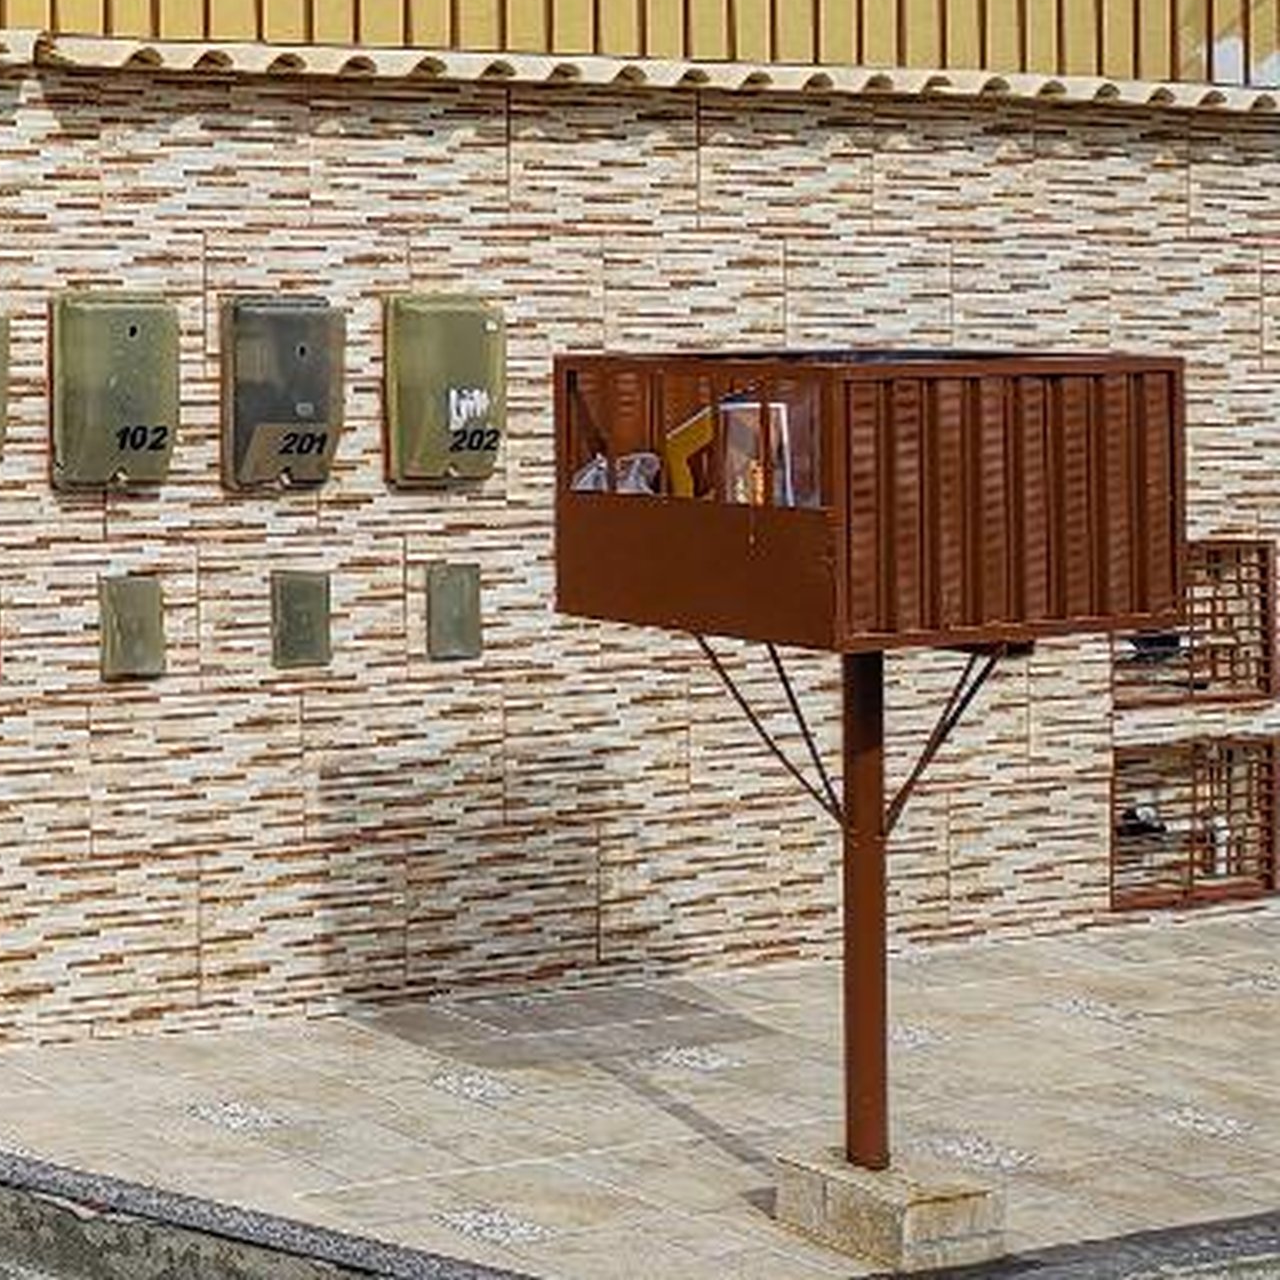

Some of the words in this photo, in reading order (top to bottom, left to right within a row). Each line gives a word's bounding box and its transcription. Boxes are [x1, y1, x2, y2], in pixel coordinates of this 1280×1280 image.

[115, 426, 169, 451] 102
[278, 432, 327, 455] 201
[449, 429, 501, 453] 202
